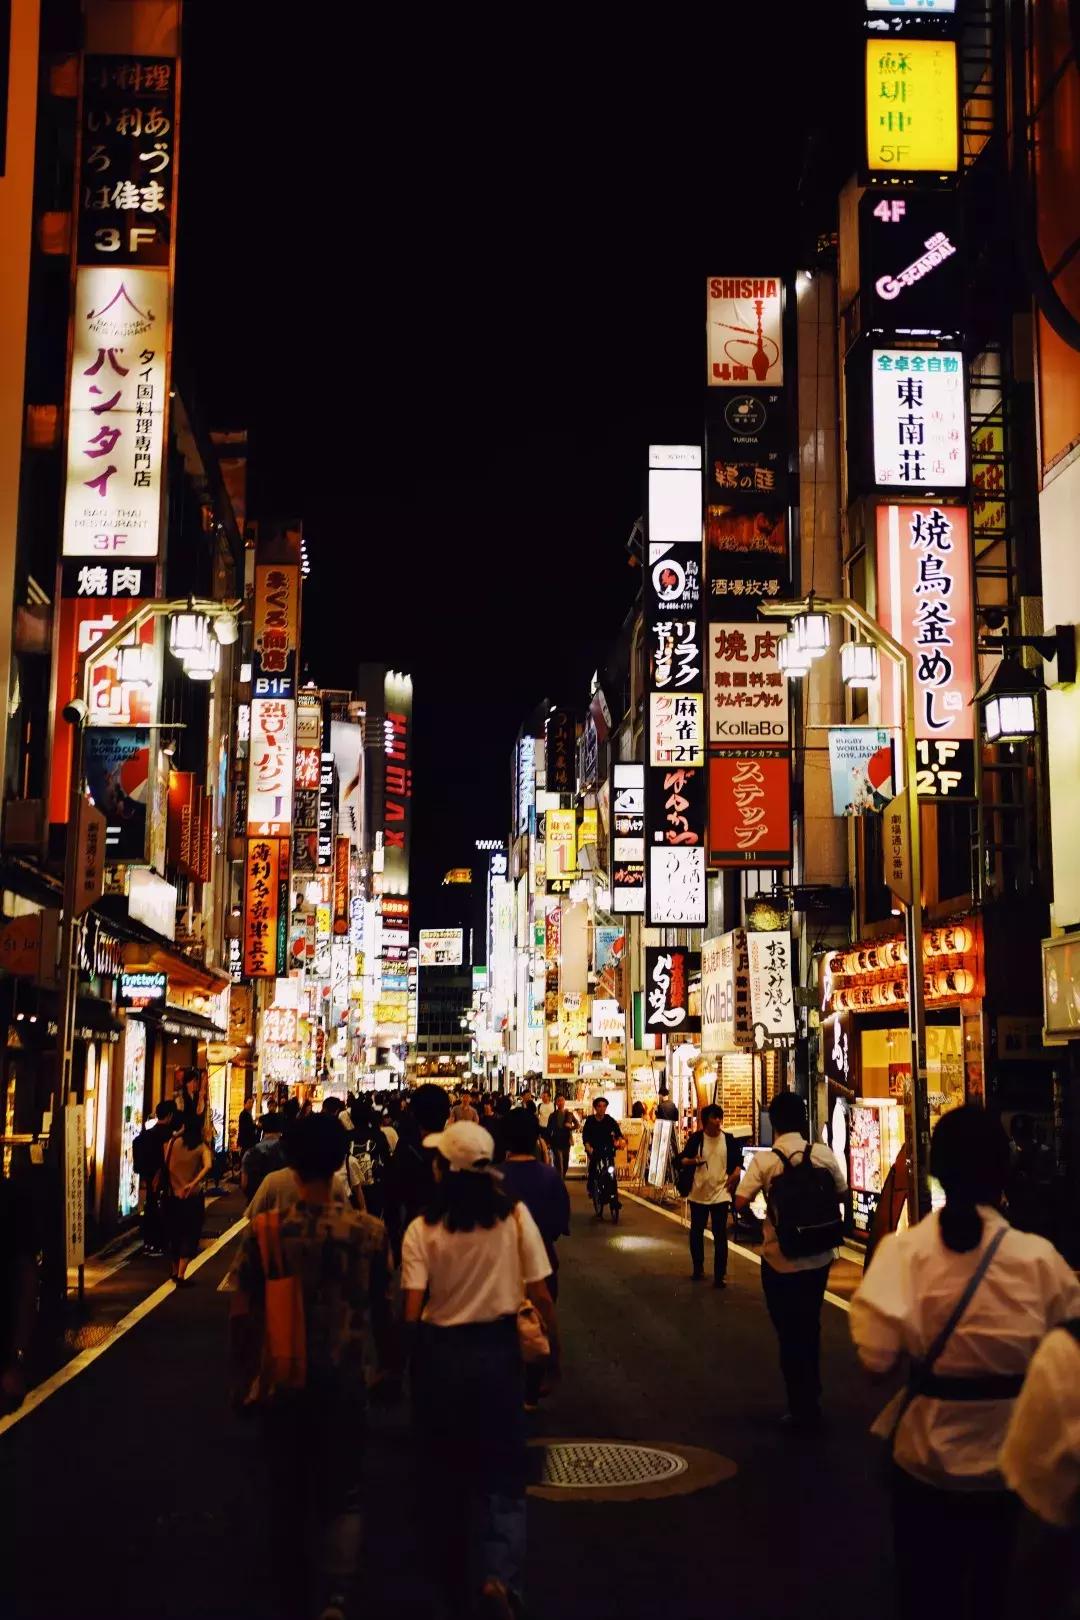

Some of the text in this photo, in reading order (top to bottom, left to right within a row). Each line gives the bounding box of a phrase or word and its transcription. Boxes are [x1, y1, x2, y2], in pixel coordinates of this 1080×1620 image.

[880, 146, 910, 162] 5F
[874, 200, 906, 222] 4F
[94, 228, 157, 252] 3F
[710, 279, 777, 298] SHISHA
[877, 355, 958, 372] 全卓全自動
[83, 348, 129, 497] バンタイ
[133, 348, 155, 487] タイ国料理専門店
[897, 377, 926, 481] 東南荘
[93, 534, 128, 550] 3F
[77, 565, 142, 596] 焼肉
[711, 578, 780, 596] 酒場牧場
[912, 510, 953, 730] 焼鳥釜めし
[674, 621, 699, 688] リラク
[256, 678, 291, 694] B1F
[714, 671, 783, 688] 韓国料理
[714, 690, 784, 708] サムギョプサル
[674, 696, 698, 741] 麻雀
[716, 720, 785, 736] KollaBo
[674, 745, 699, 762] 2F
[720, 749, 780, 758] オンラインカフェ
[917, 741, 960, 765] 1F
[917, 770, 962, 795] 2F
[731, 760, 769, 849] ステップ
[258, 822, 280, 836] 4F
[121, 972, 165, 986] Trattoria
[763, 939, 791, 1023] お好み焼き
[773, 1037, 796, 1048] B1F
